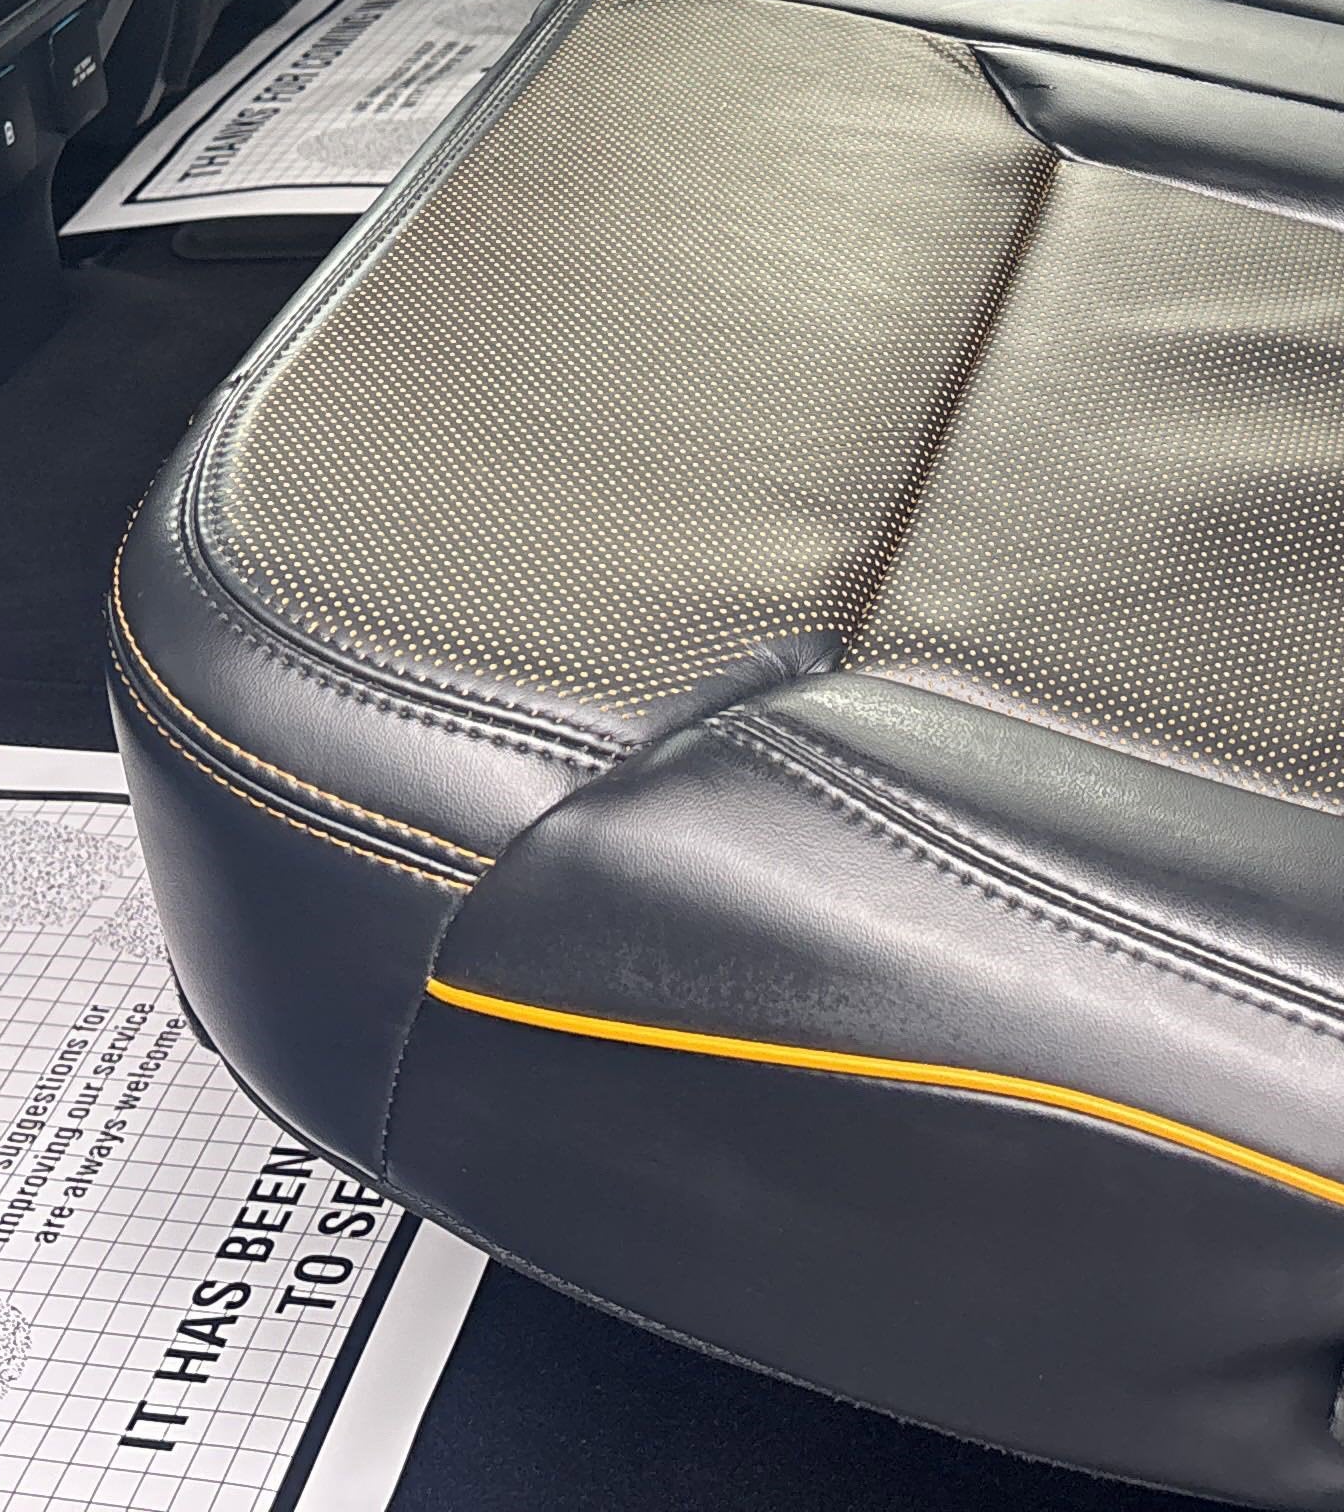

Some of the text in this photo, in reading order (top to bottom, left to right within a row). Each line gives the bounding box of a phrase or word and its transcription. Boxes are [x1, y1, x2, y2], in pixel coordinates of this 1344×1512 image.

[177, 107, 281, 183] THANKS
[253, 72, 320, 103] FOR
[291, 13, 384, 69] COMING
[68, 1082, 104, 1119] our
[93, 1002, 155, 1078] service
[71, 1004, 110, 1032] for
[34, 1017, 187, 1244] are always welcome
[118, 1147, 319, 1452] IT HAS BEEN
[275, 1254, 354, 1314] TO
